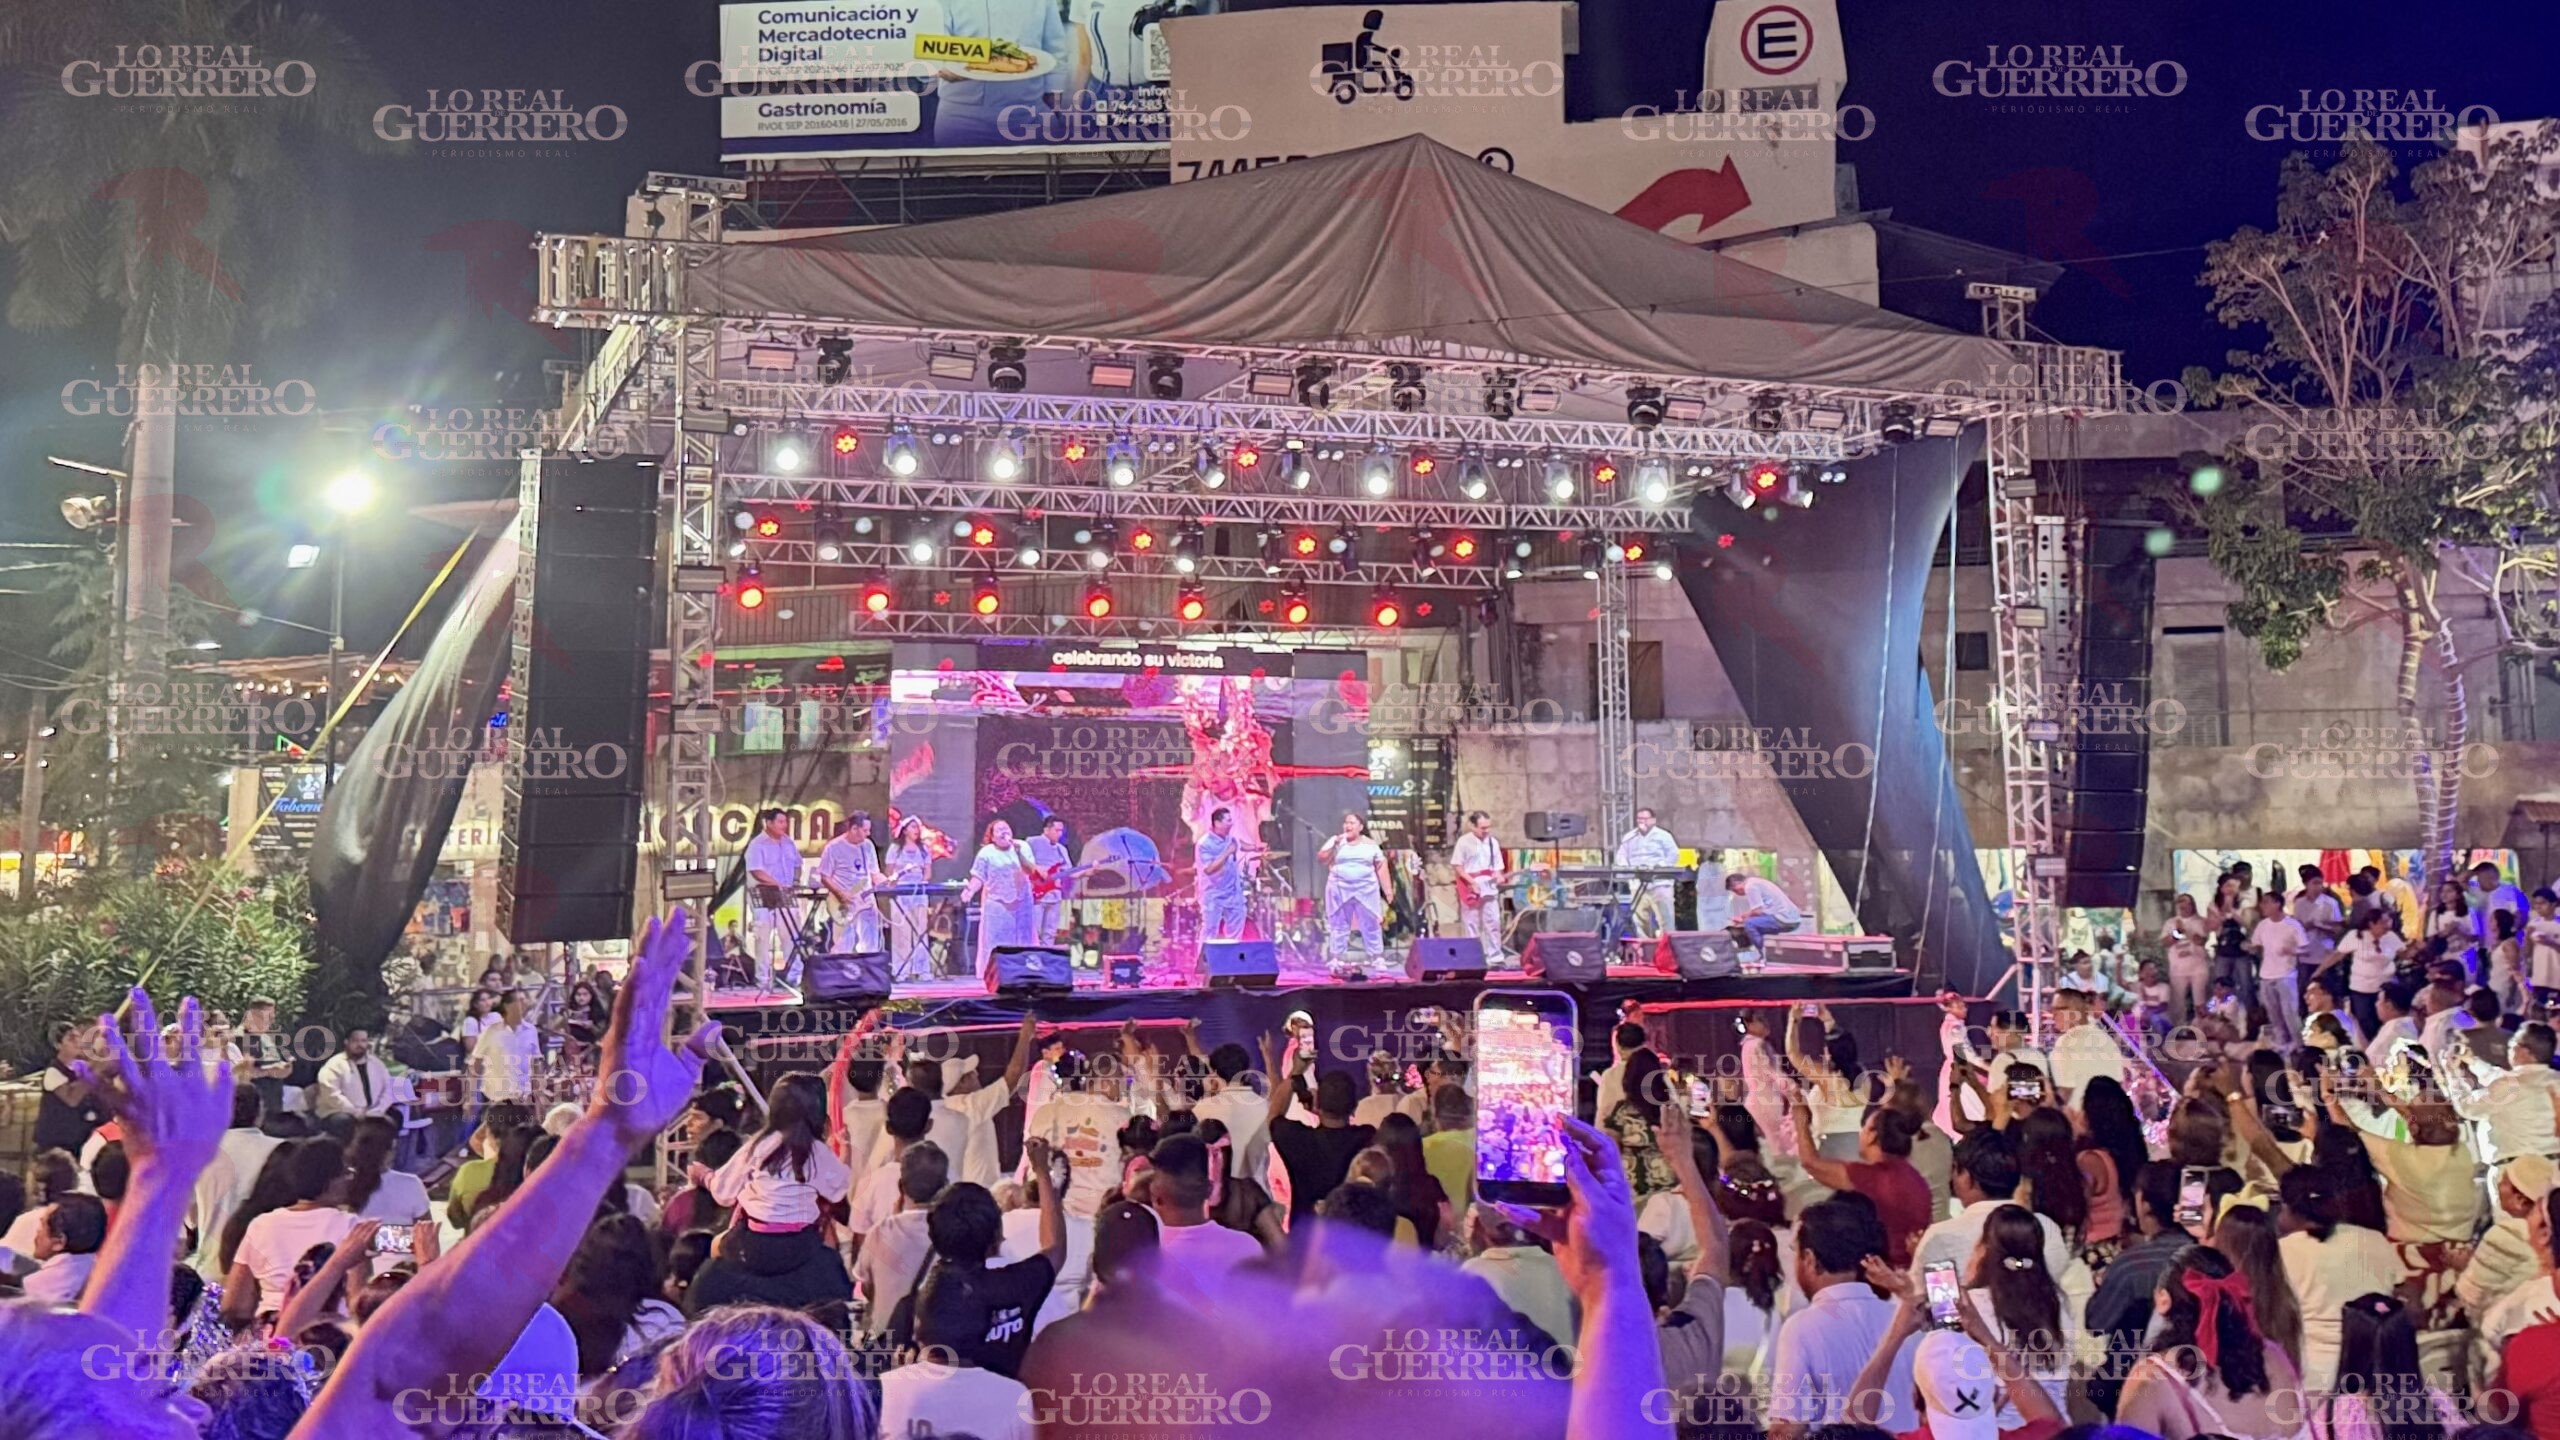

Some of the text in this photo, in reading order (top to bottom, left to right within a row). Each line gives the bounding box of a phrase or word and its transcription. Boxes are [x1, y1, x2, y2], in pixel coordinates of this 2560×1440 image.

[758, 5, 918, 24] Comunicación y
[758, 24, 906, 43] Mercadotecnia
[758, 45, 822, 65] Digital
[922, 40, 984, 57] NUEVA
[758, 98, 887, 117] Gastronomía
[757, 121, 782, 131] RVOE
[785, 121, 802, 130] SEP
[1052, 650, 1223, 669] celebrando su victoria
